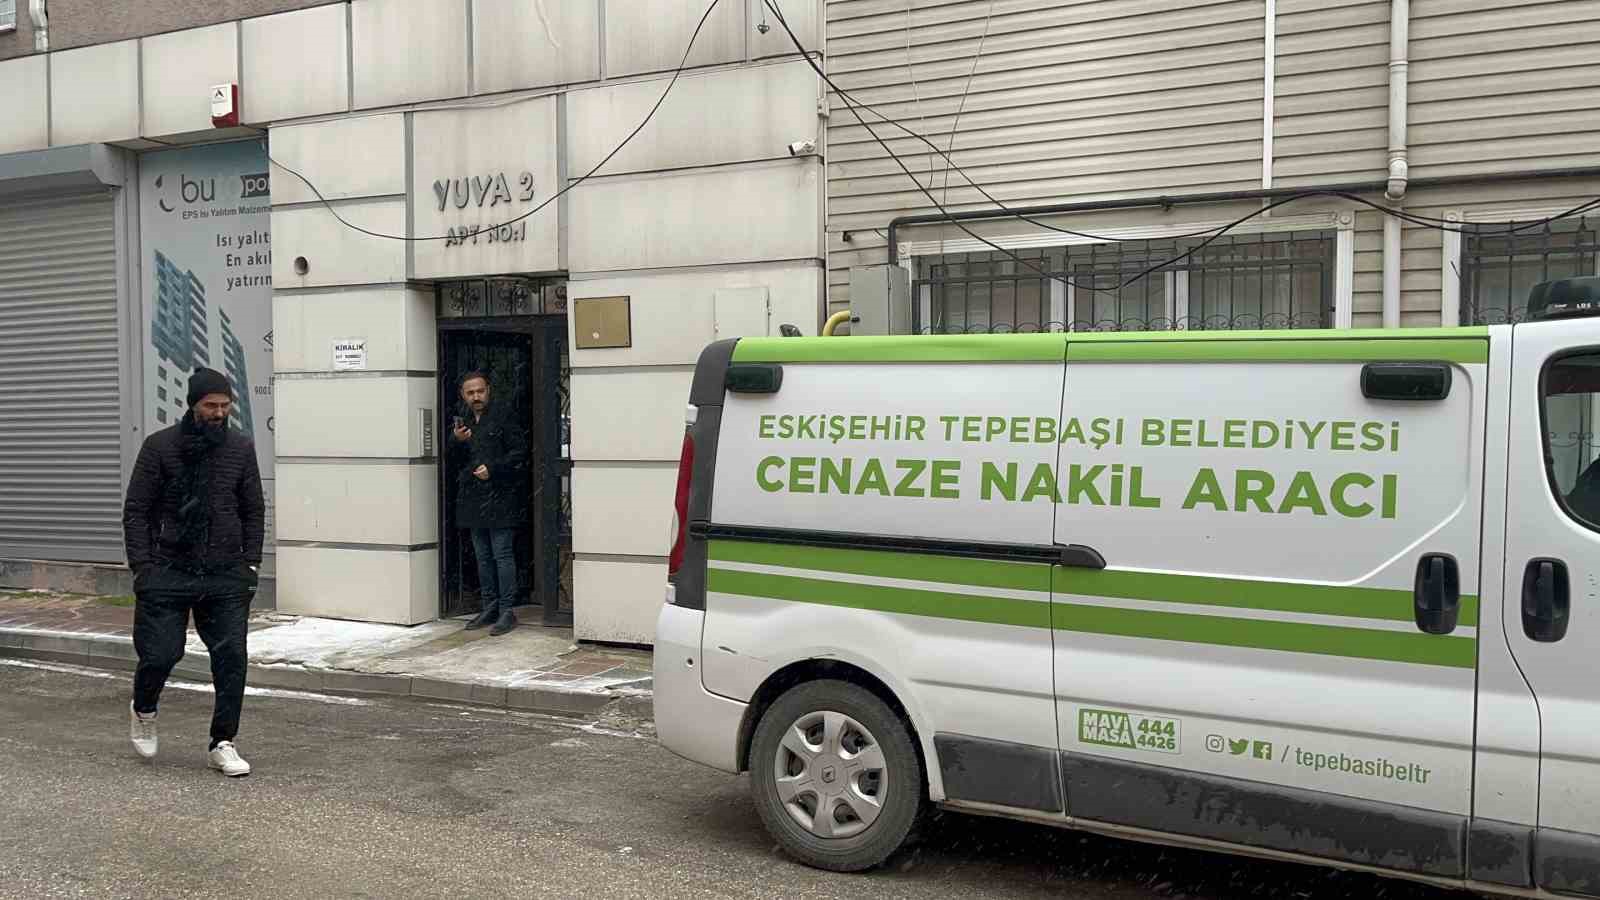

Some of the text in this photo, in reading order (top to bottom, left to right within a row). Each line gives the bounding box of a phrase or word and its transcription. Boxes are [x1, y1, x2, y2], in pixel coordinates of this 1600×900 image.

[433, 171, 534, 211] YUVA 2
[445, 224, 480, 247] APT
[226, 253, 241, 267] En
[939, 416, 1123, 450] TEPEBAŞI
[756, 455, 961, 499] CENAZE
[1181, 467, 1398, 520] ARACI
[1082, 726, 1132, 745] MASA
[1138, 719, 1175, 737] 444
[1137, 734, 1175, 750] 4426
[1295, 747, 1431, 784] tepebasibeltr
